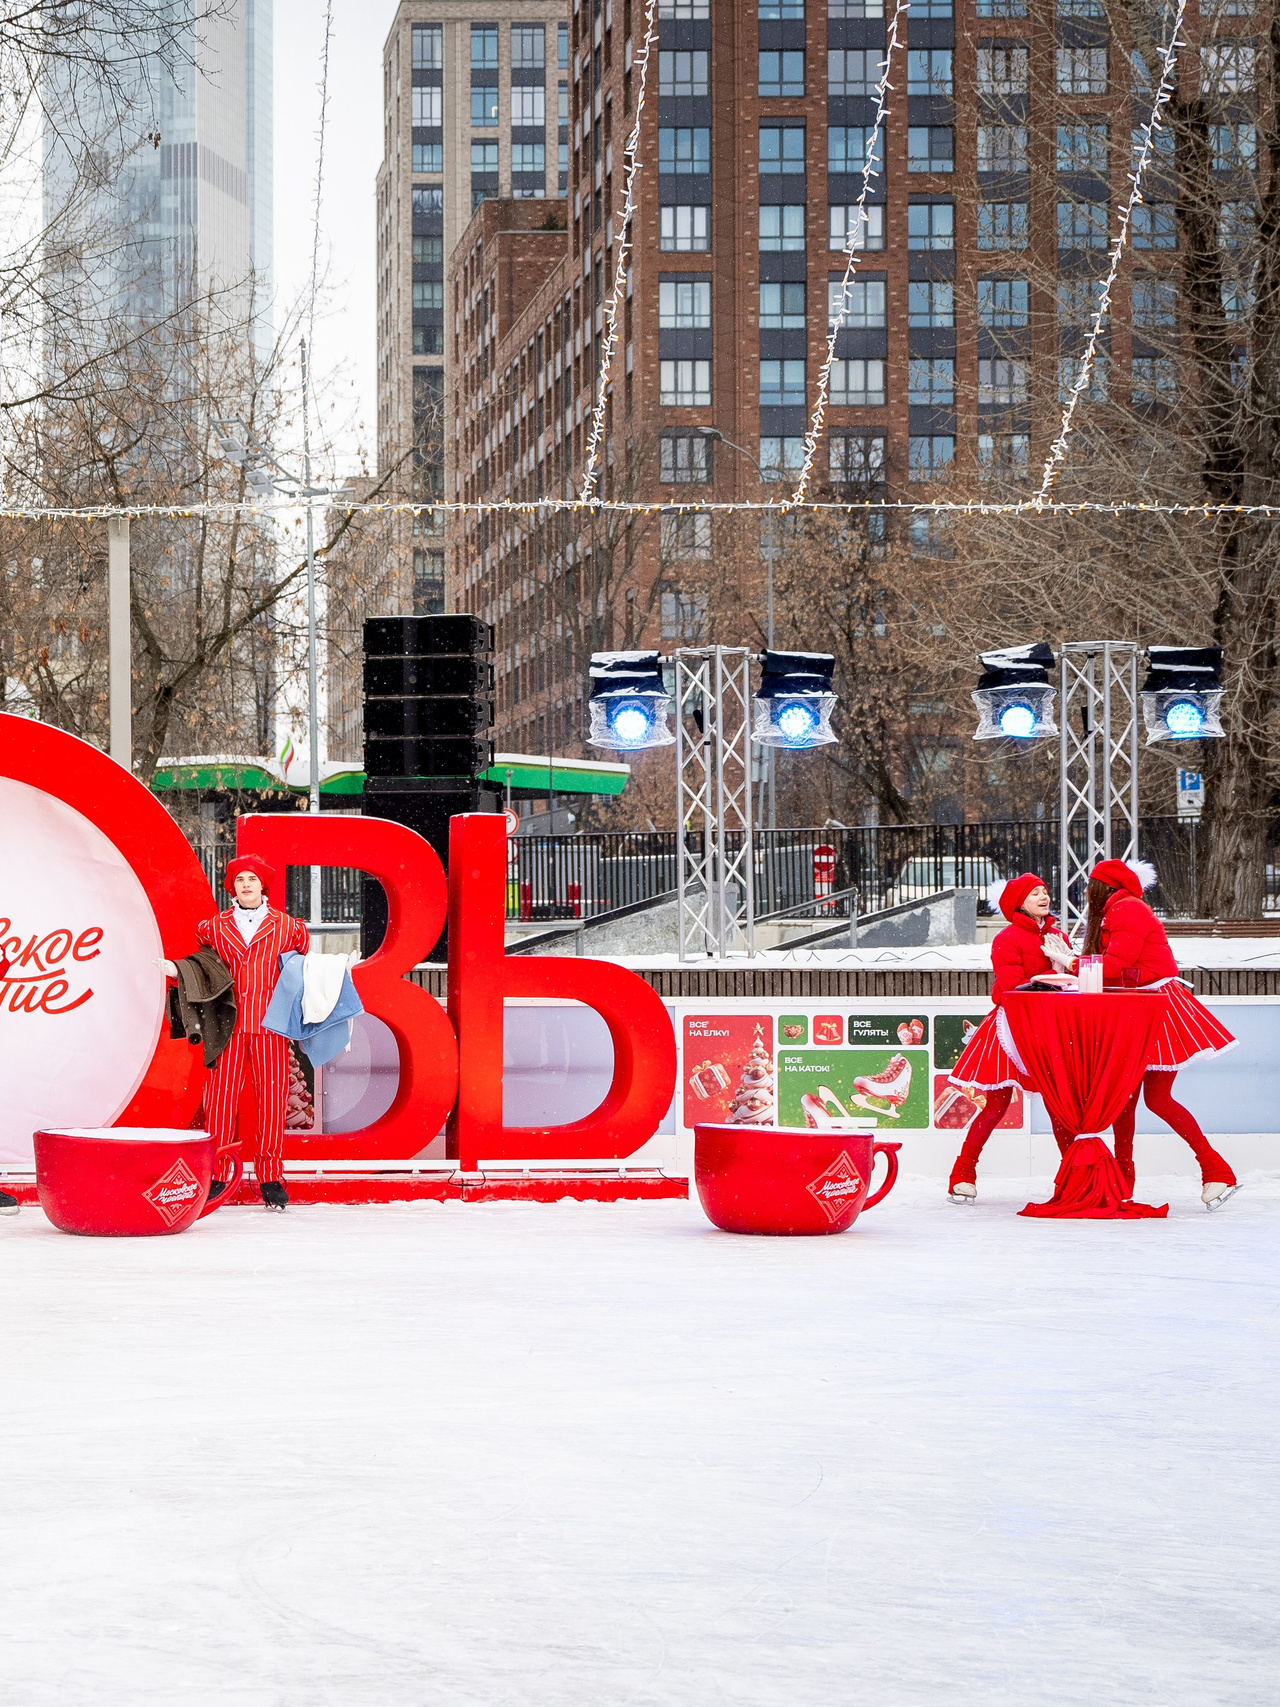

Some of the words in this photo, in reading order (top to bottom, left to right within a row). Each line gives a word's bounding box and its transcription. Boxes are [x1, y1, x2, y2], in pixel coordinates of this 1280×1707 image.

[853, 1020, 872, 1028] ВСЕ
[689, 1029, 703, 1037] НА
[853, 1029, 889, 1037] ГУЛЯТЬ!
[784, 1056, 803, 1064] ВСЕ
